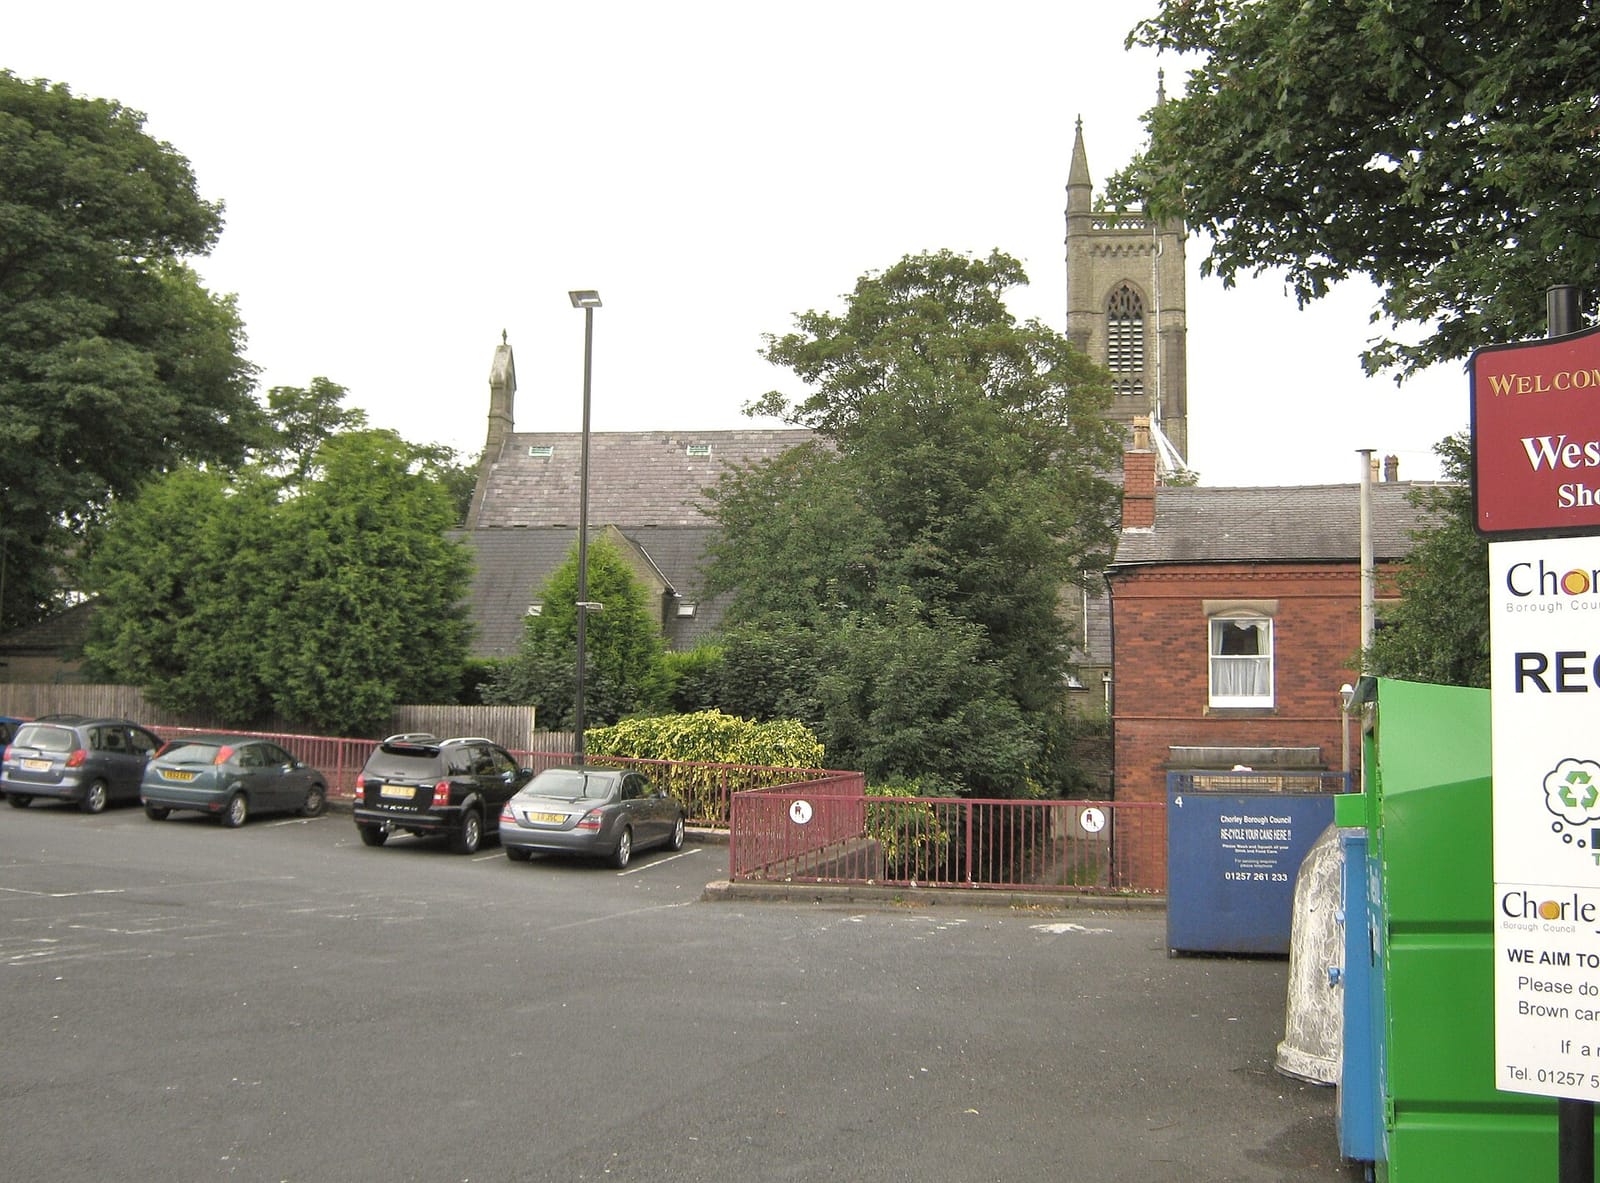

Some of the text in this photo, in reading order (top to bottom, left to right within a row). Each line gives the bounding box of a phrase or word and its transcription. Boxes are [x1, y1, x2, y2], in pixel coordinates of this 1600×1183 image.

[1506, 601, 1563, 613] Borough
[1514, 651, 1600, 693] RE
[1174, 796, 1183, 808] 4
[1220, 815, 1292, 825] Chorley Borough Council
[1245, 828, 1259, 840] YOUR
[1259, 828, 1273, 840] CANS
[1273, 829, 1287, 841] HERE
[1225, 872, 1288, 881] 01257 261 233
[1502, 890, 1600, 934] Chorle
[1503, 921, 1576, 933] Borough Council
[1507, 949, 1600, 969] WE AIM TO
[1518, 975, 1599, 996] Please do
[1518, 1000, 1569, 1018] Brown
[1561, 1039, 1571, 1054] If
[1581, 1045, 1591, 1057] a
[1507, 1065, 1532, 1081] Tel.
[1537, 1068, 1585, 1086] 01257
